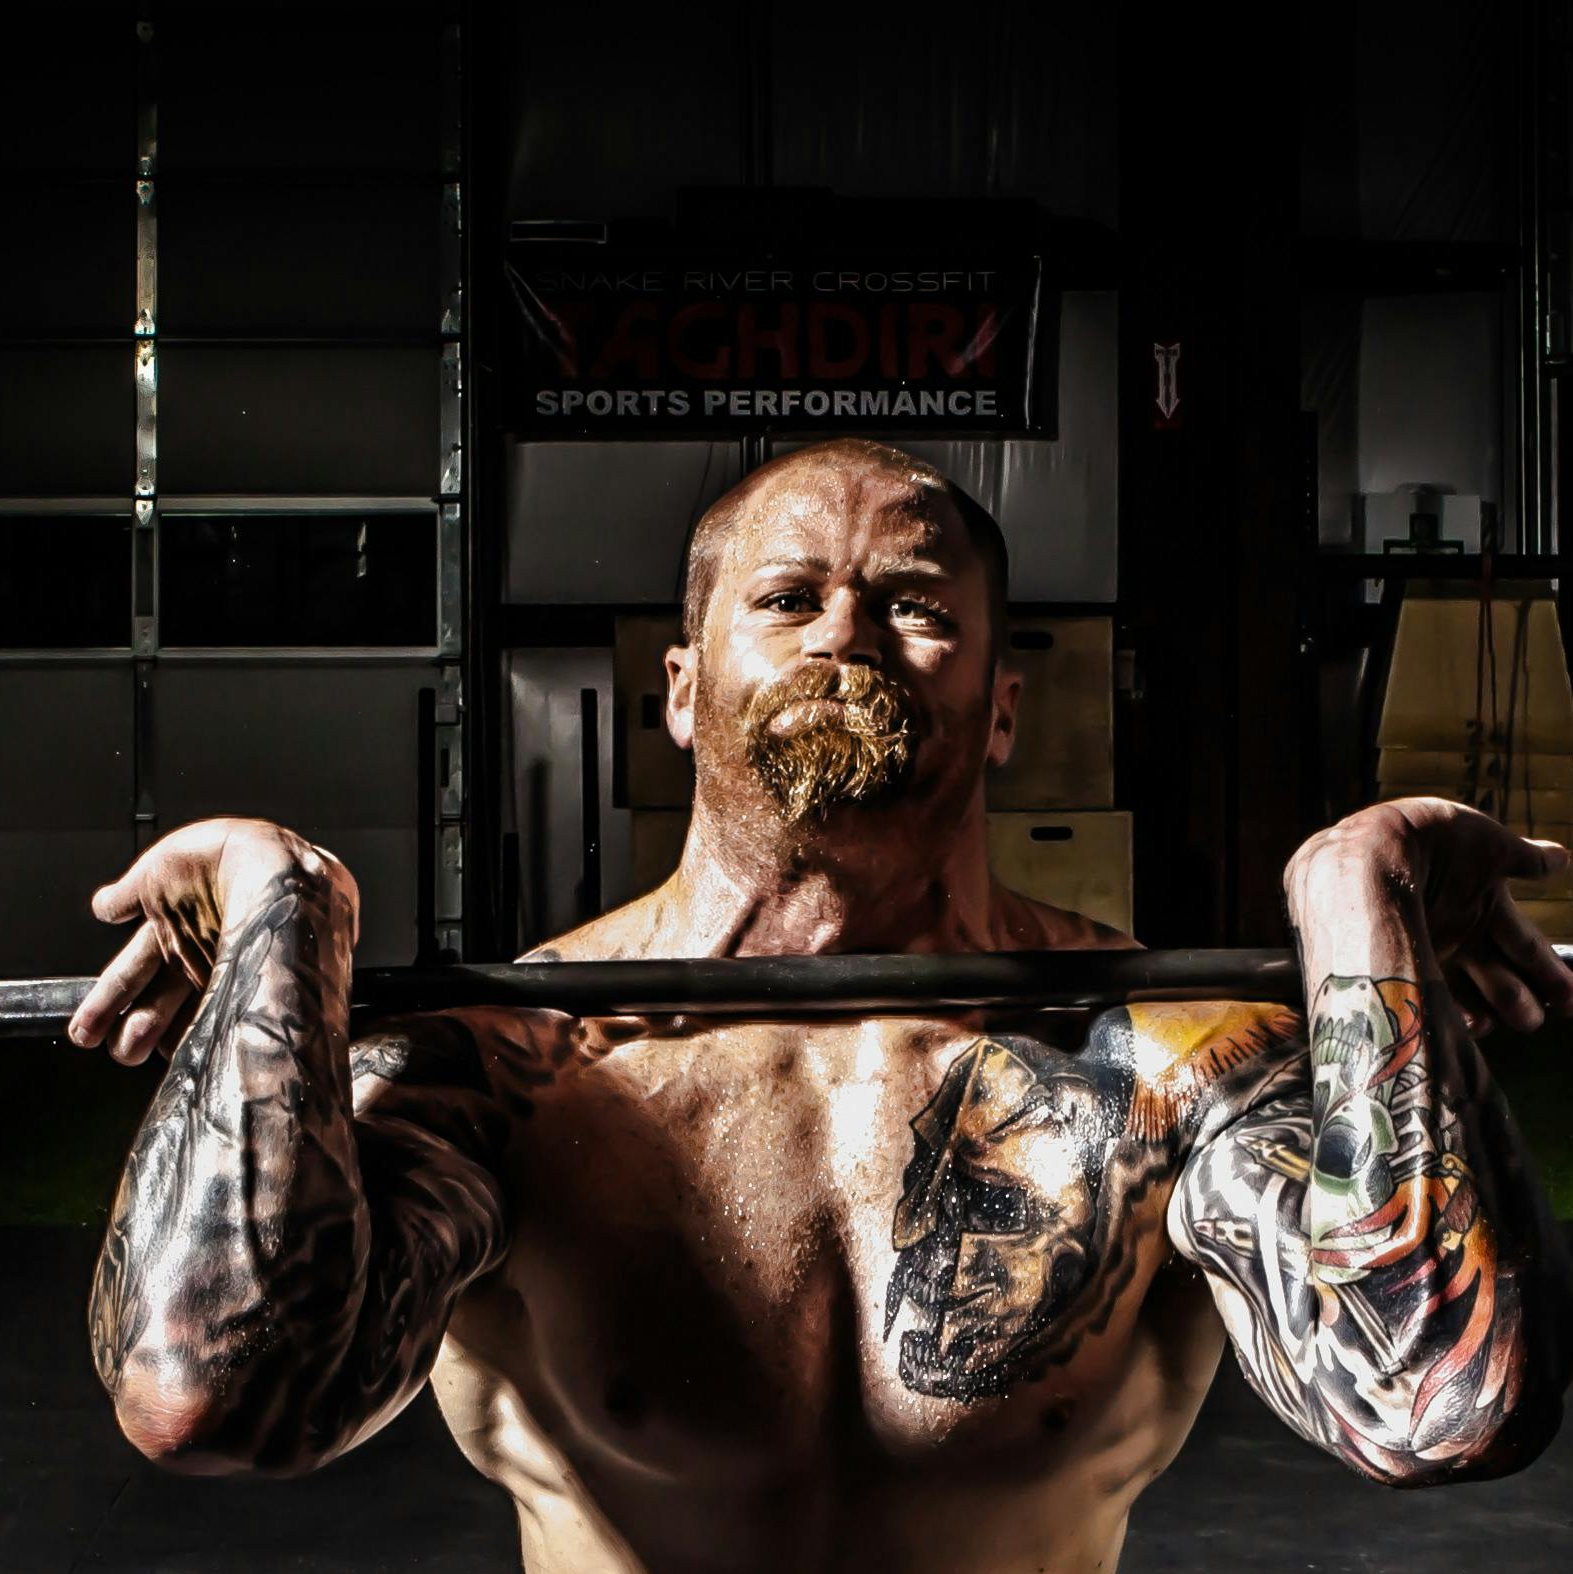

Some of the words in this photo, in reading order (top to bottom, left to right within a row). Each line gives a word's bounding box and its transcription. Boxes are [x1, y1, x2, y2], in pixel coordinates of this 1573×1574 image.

[535, 271, 665, 293] SNAKE
[683, 271, 795, 292] RIVER
[812, 271, 997, 292] CROSSFIT
[536, 389, 690, 416] SPORTS
[704, 389, 997, 416] PERFORMANCE
